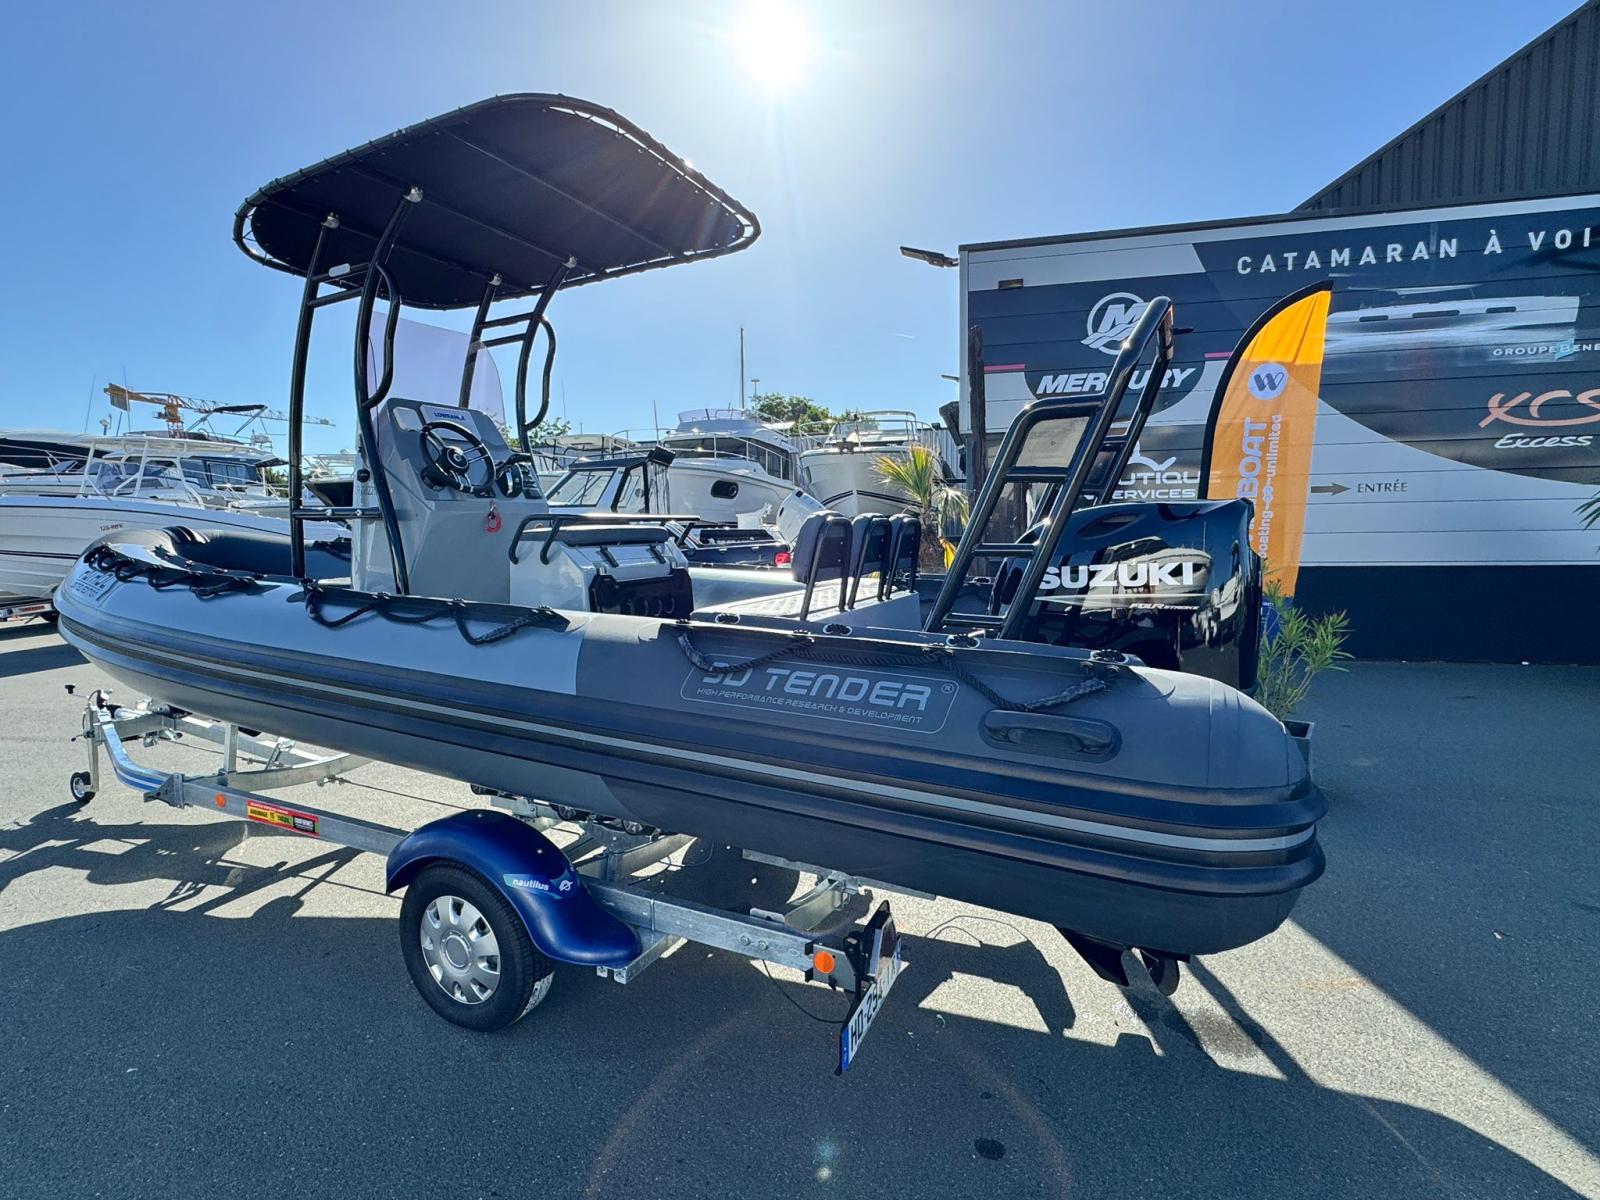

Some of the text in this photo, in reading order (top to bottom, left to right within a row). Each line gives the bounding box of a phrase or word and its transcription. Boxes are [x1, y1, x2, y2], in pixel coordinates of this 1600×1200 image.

[1236, 227, 1592, 275] CATAMARAN À VOI
[1266, 414, 1282, 478] unlimited
[1494, 432, 1593, 449] Excess
[1112, 488, 1196, 500] ERVICES
[1357, 478, 1408, 493] ENTRÉE
[1039, 561, 1194, 590] SUZUKI
[765, 667, 932, 711] TENDER
[696, 687, 718, 697] HIGH
[718, 690, 784, 706] PERFORMANCE
[784, 698, 838, 714] RESEARCH
[847, 707, 923, 725] DEVELOPMENT
[512, 879, 550, 891] nautilus
